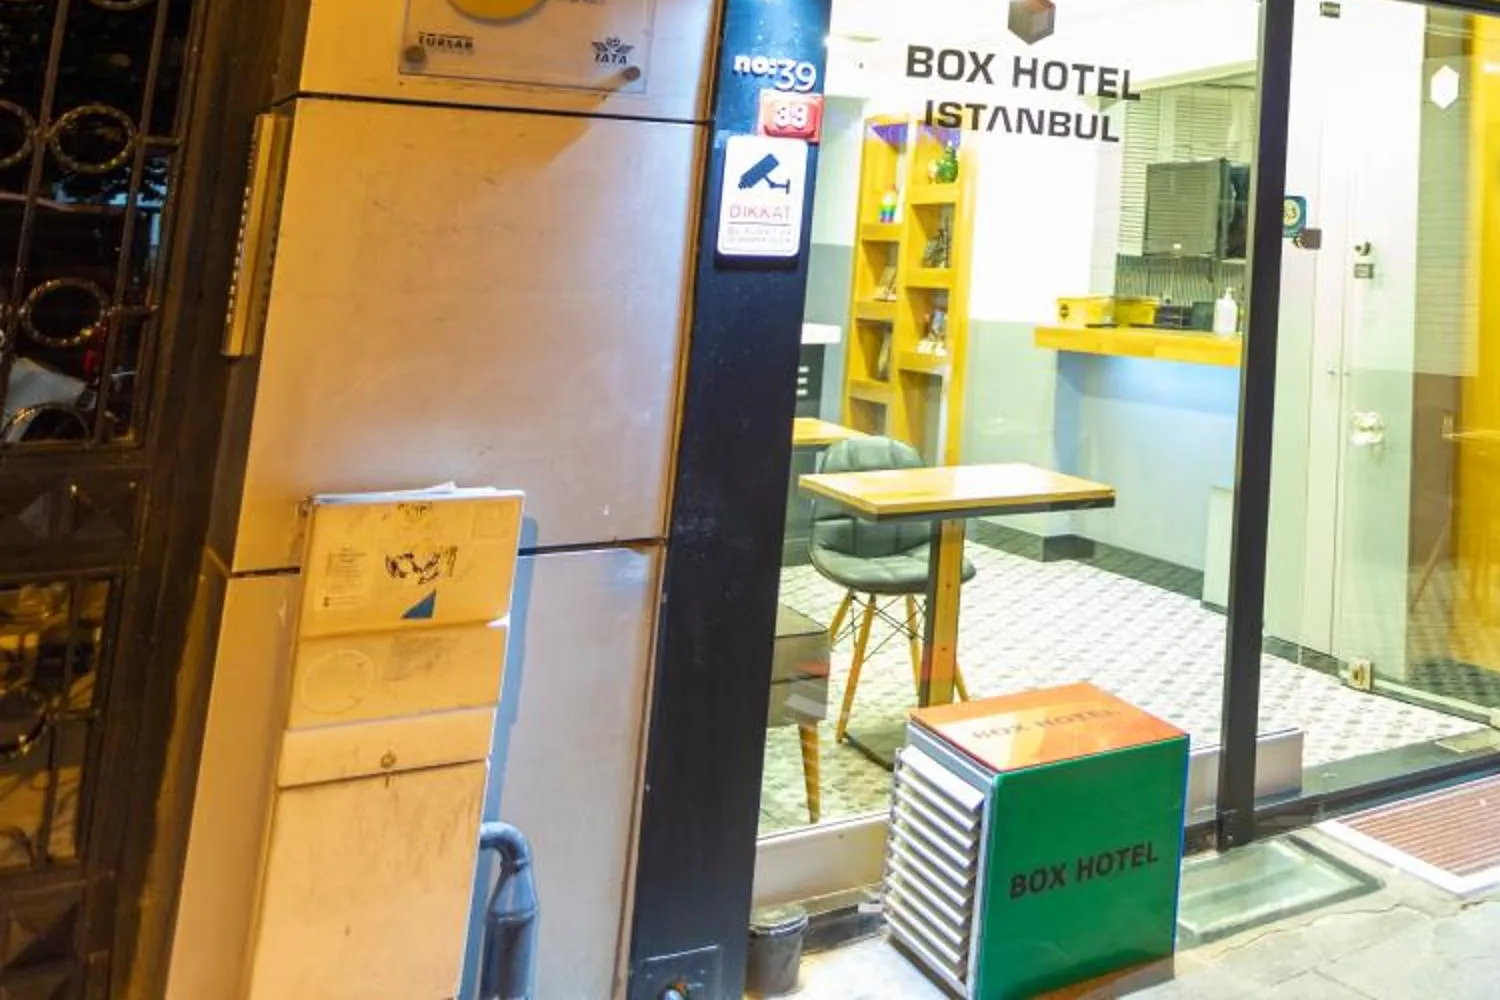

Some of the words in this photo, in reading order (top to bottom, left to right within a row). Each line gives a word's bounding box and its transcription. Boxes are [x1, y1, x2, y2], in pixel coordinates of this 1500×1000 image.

[905, 44, 996, 85] BOX
[1012, 55, 1141, 101] HOTEL
[971, 721, 1030, 741] BOX
[1035, 705, 1122, 730] HOTEL
[1009, 863, 1067, 901] BOX
[1077, 840, 1159, 883] HOTEL
